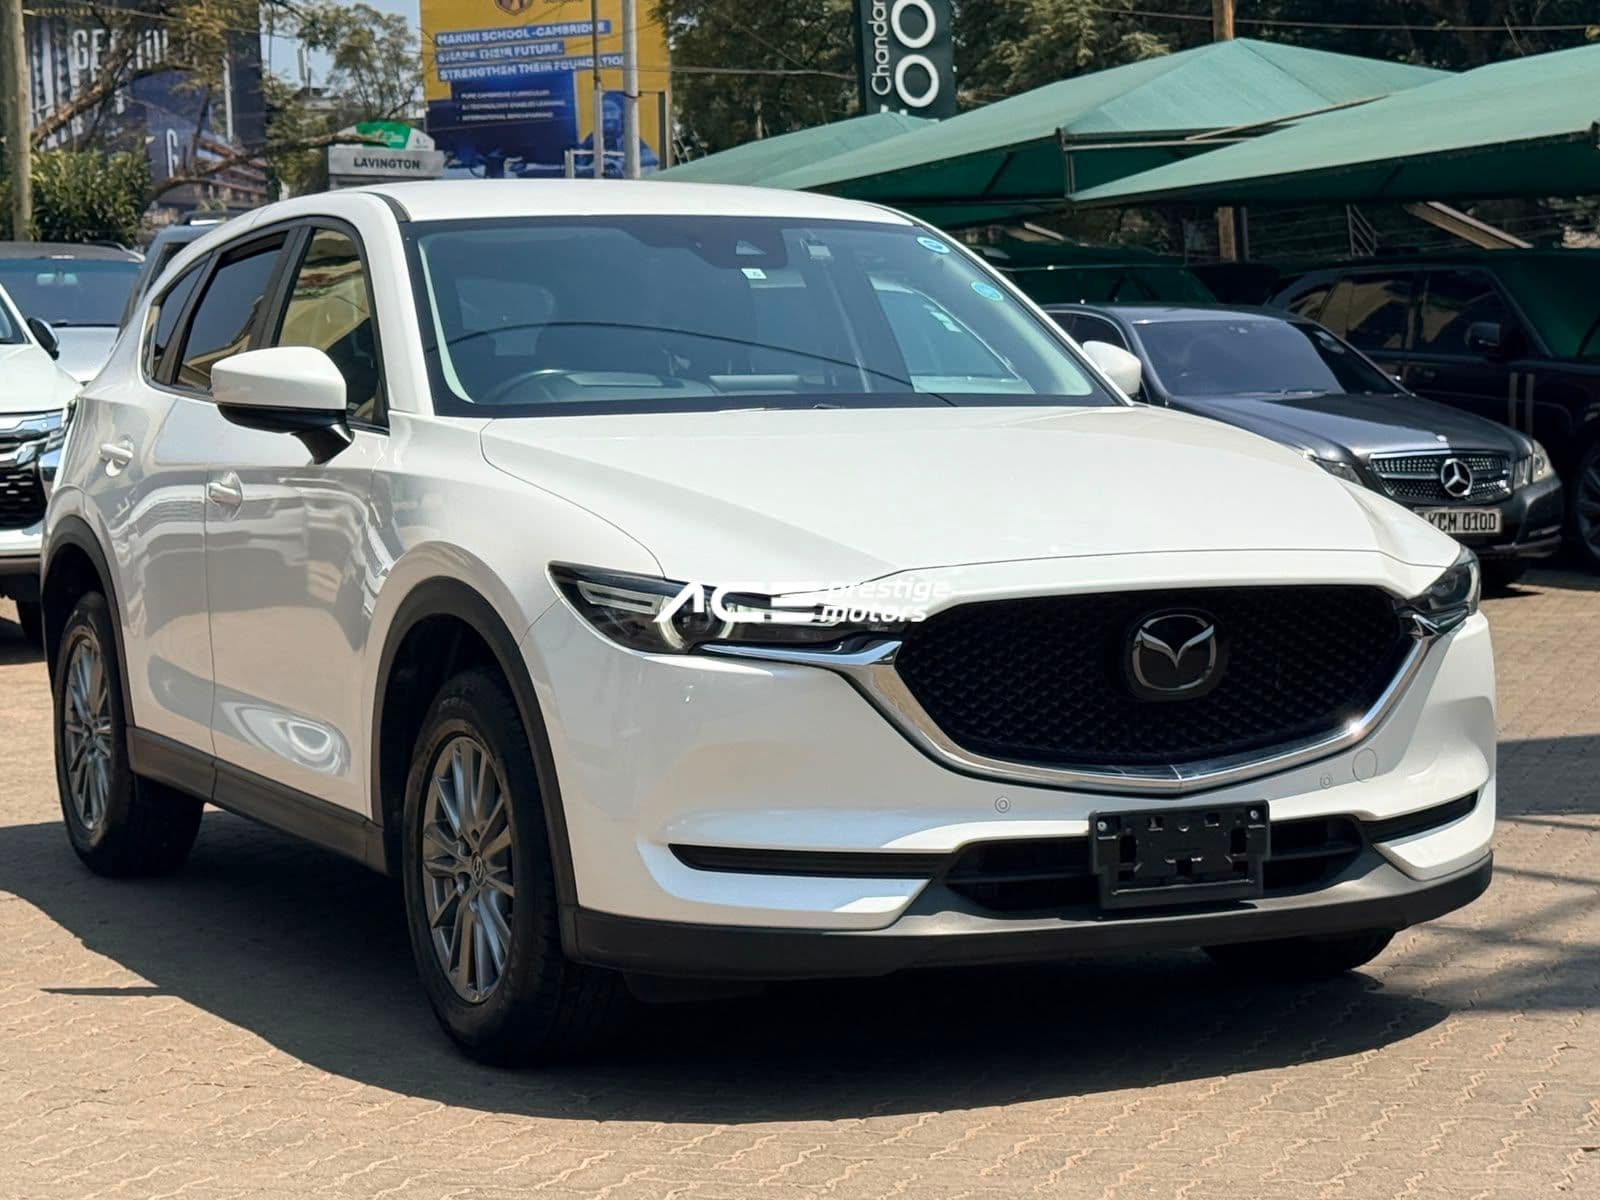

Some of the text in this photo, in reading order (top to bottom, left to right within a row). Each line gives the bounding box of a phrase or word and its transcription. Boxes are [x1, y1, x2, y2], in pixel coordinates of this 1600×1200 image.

[437, 33, 480, 45] MAKINI
[482, 28, 530, 41] SCHOOL
[480, 47, 513, 59] THEIR
[440, 55, 624, 80] STRENGTHEN THEIR FOUNDTIO
[354, 158, 420, 169] LAVINGTON
